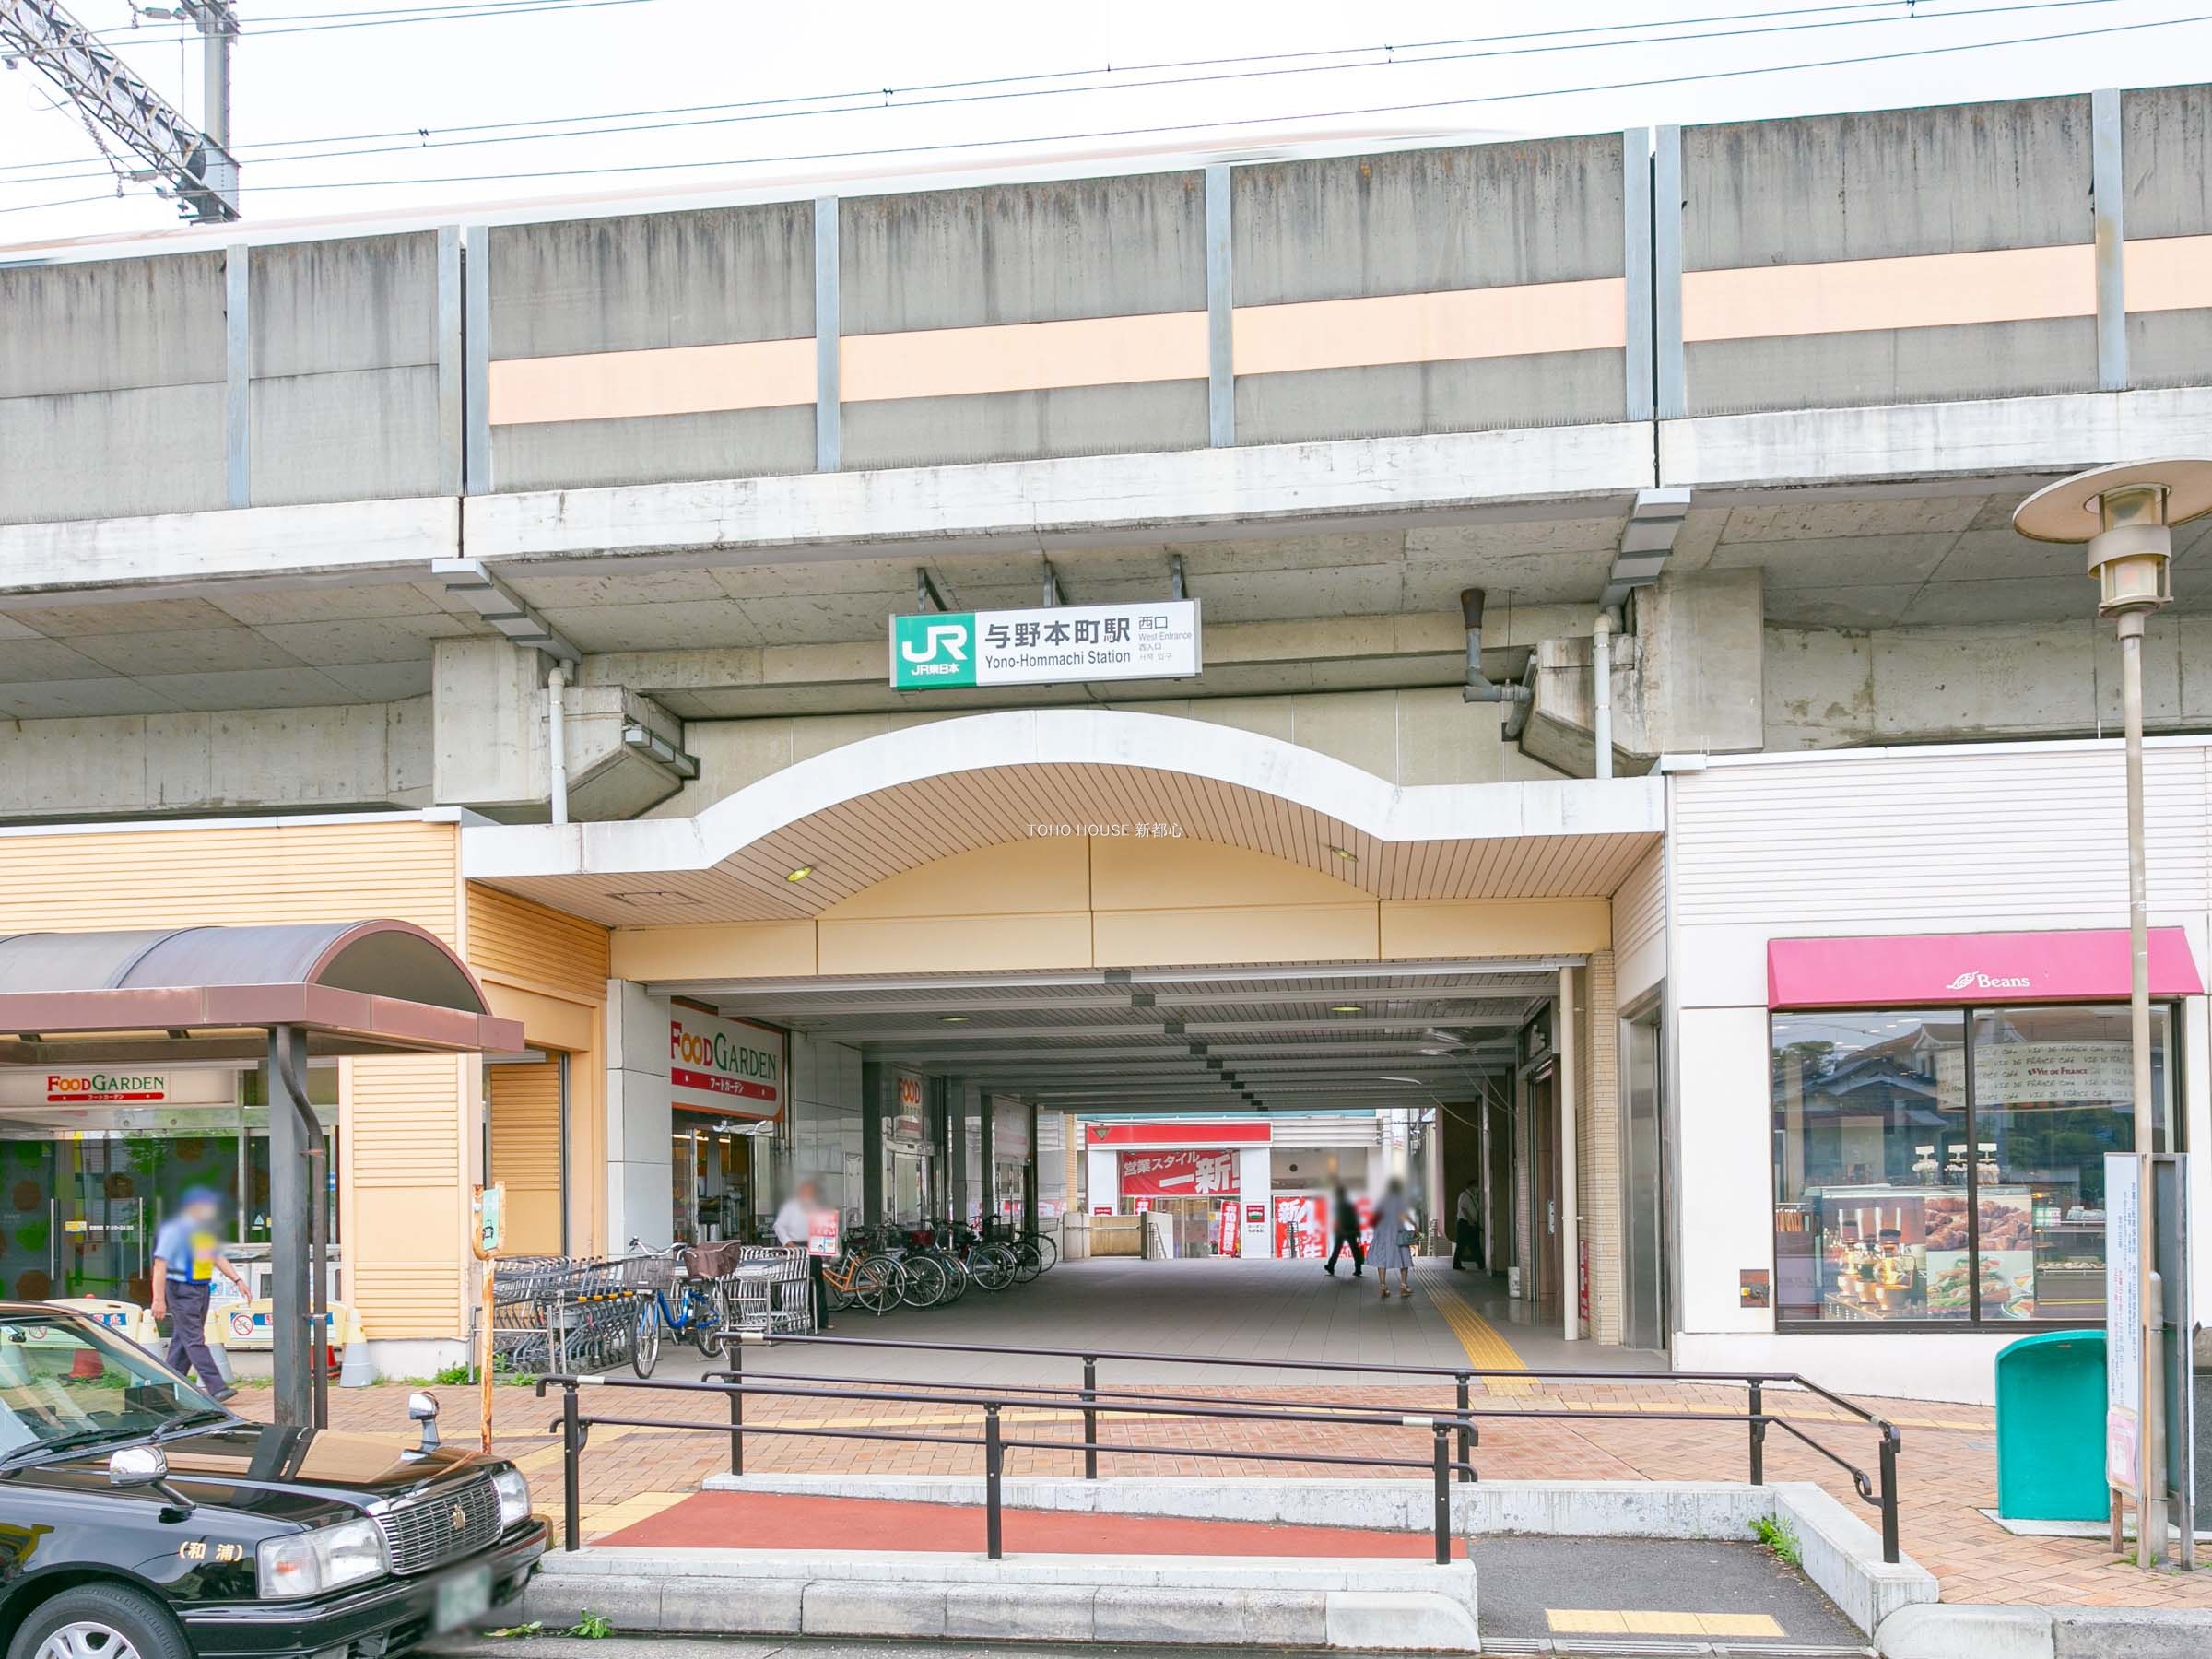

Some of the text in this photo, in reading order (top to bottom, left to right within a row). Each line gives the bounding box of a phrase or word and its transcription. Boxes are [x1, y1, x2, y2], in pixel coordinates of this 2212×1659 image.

[1138, 616, 1168, 630] 西口
[984, 618, 1131, 649] 与野本町駅
[1138, 631, 1193, 641] West Entrance
[901, 624, 969, 664] JR
[985, 648, 1131, 669] Yono-Hommachi Station
[911, 663, 959, 677] JR東日本
[1976, 973, 2030, 988] Beans
[1124, 1151, 1200, 1177] 営業スタイル
